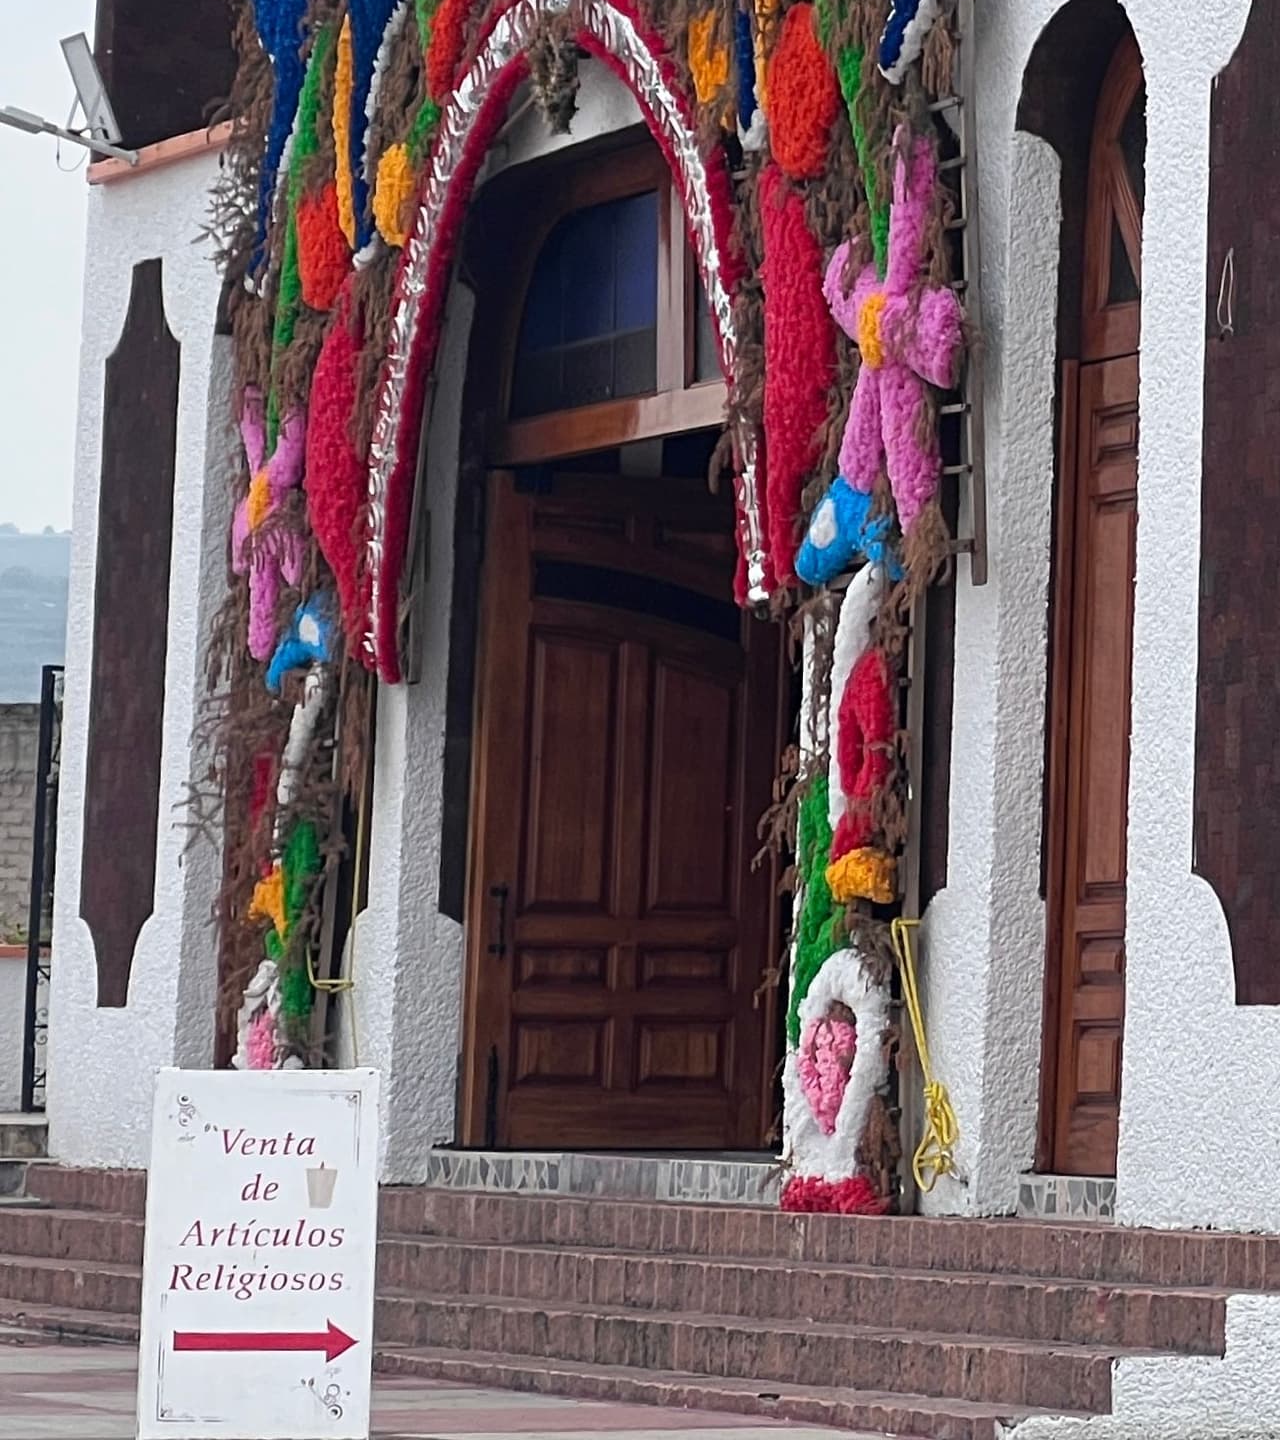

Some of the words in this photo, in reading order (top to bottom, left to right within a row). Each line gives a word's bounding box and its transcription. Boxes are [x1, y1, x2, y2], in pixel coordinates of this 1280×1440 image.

[222, 1128, 316, 1156] Venta
[240, 1173, 280, 1202] de
[178, 1218, 345, 1248] Artículos
[168, 1263, 345, 1301] Religiosos
